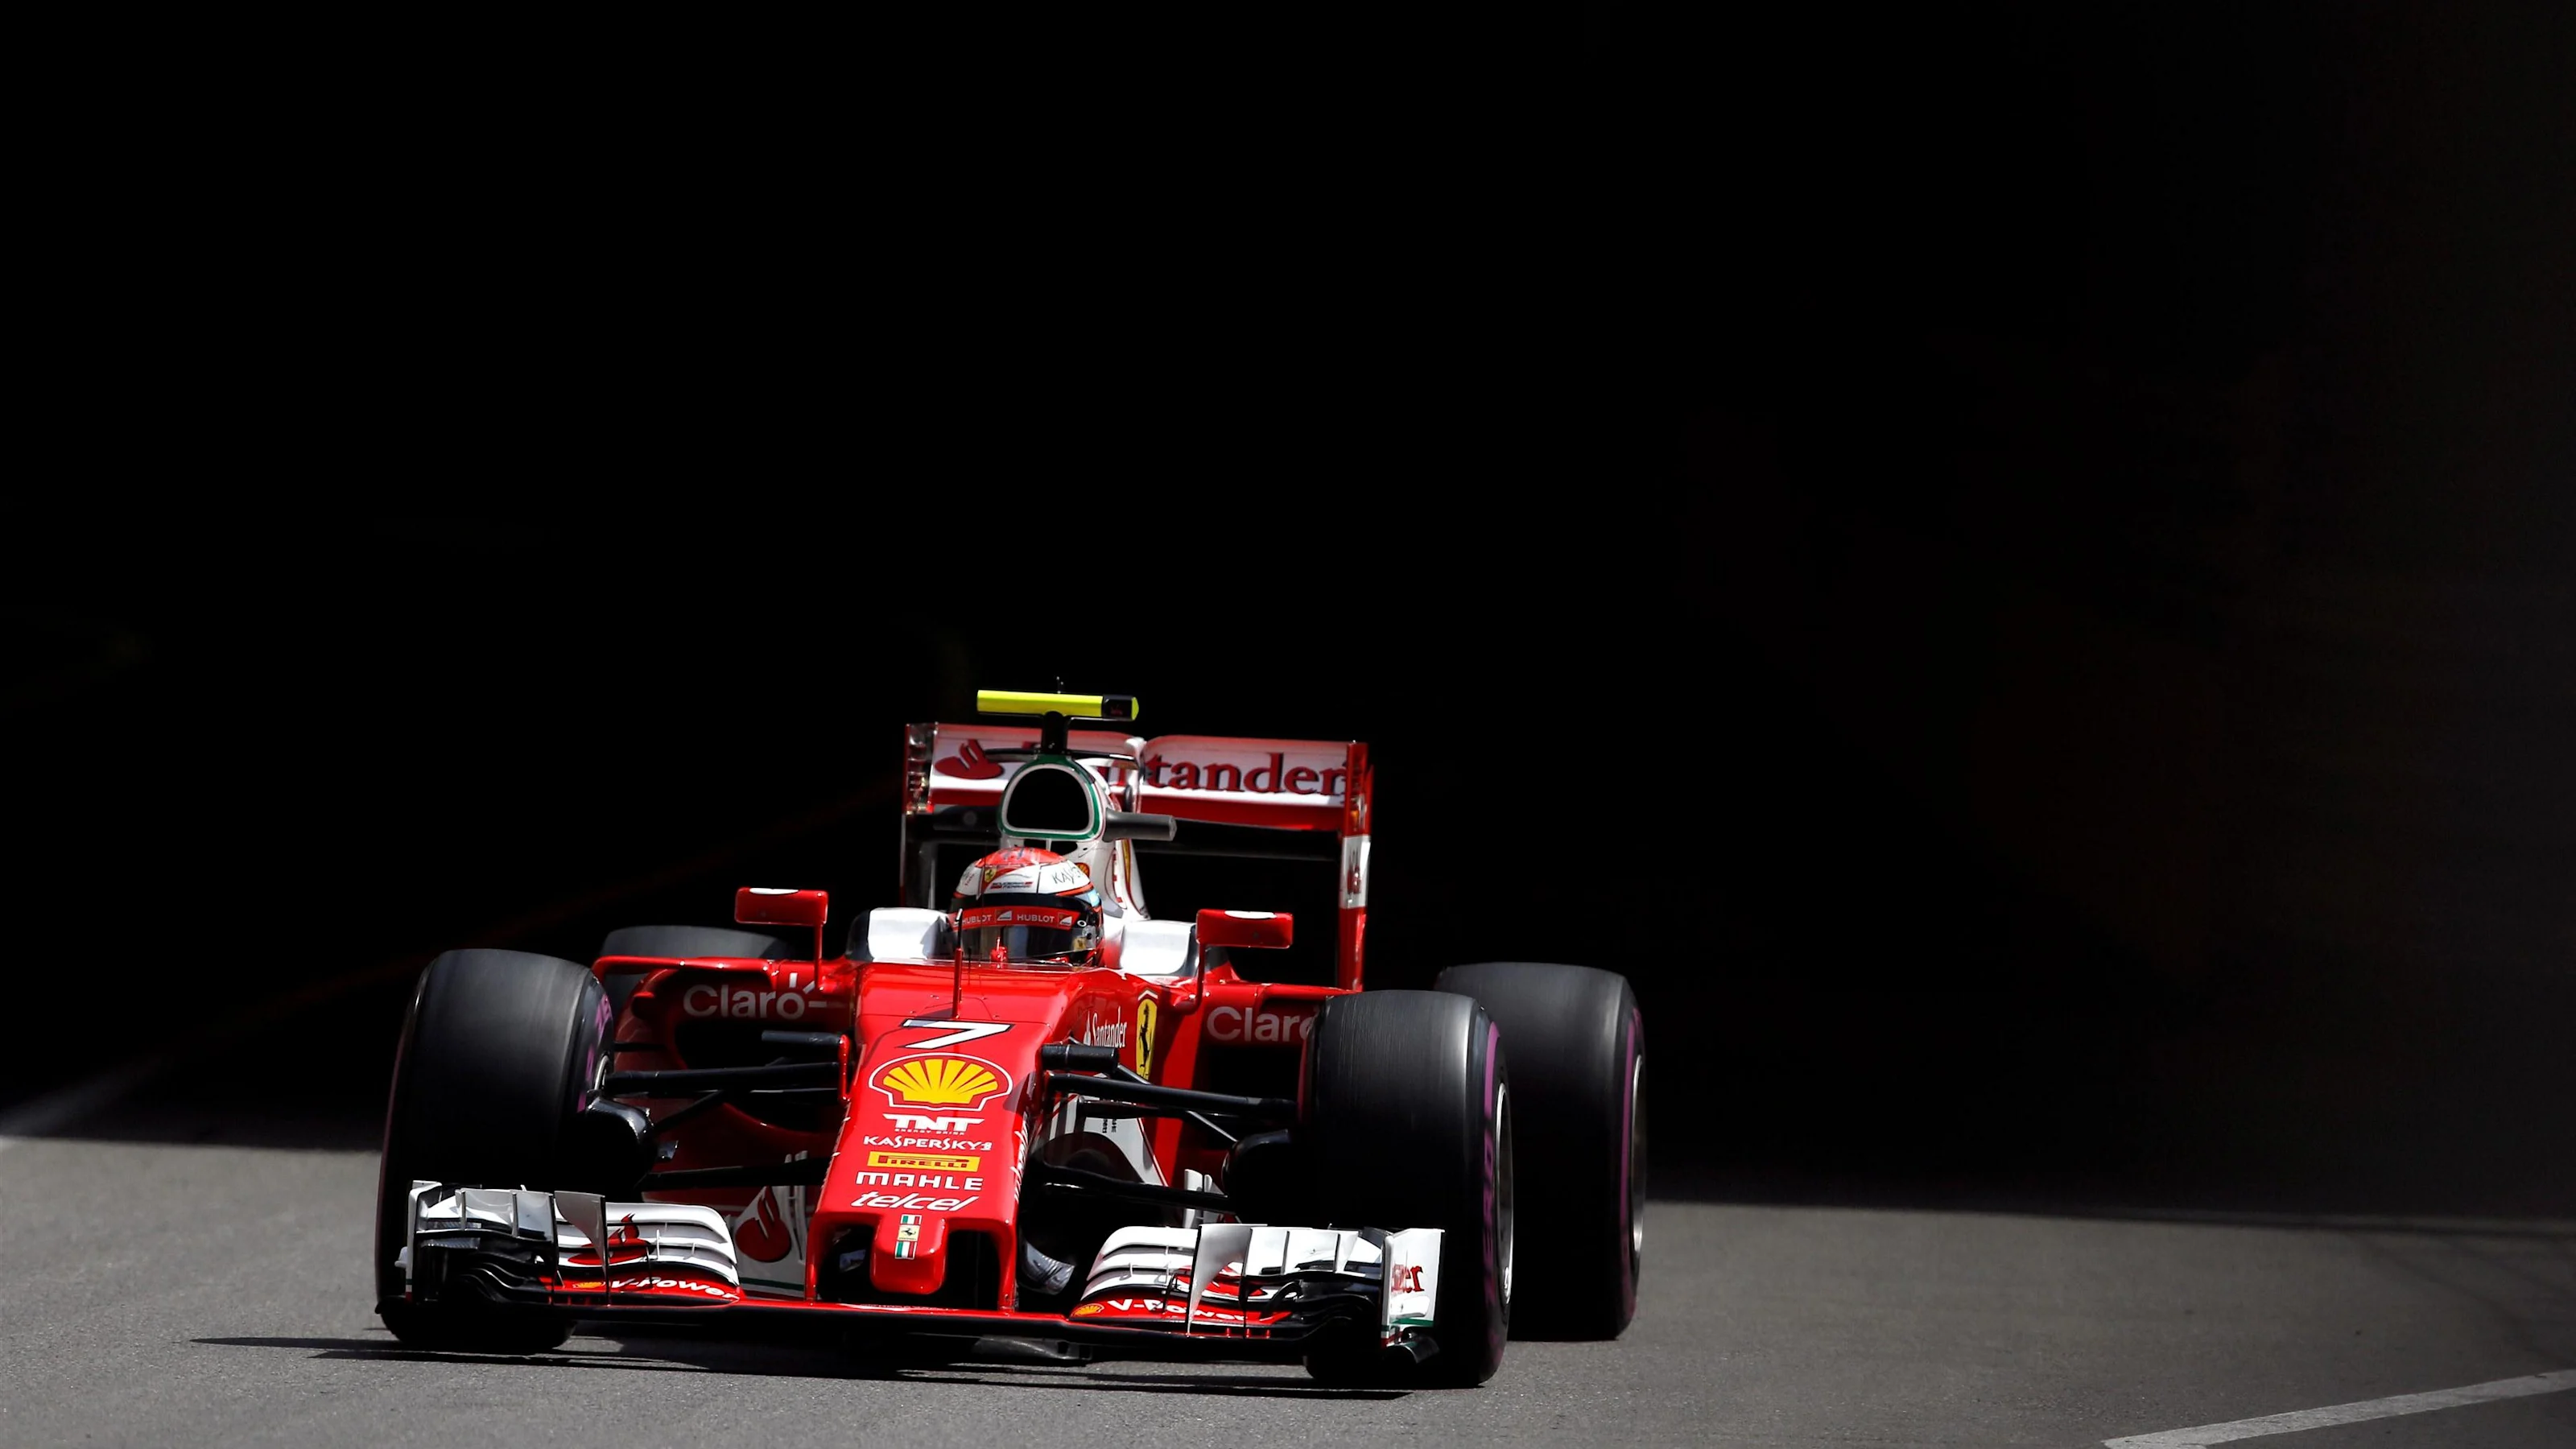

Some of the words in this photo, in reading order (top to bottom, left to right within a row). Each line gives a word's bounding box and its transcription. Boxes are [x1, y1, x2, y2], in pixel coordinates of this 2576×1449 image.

[1017, 914, 1055, 923] HUBLOT
[684, 984, 806, 1020] Claro
[897, 1018, 1015, 1050] 7
[1092, 1005, 1127, 1048] Santander
[882, 1113, 985, 1133] TNT
[877, 1154, 969, 1168] PIRELLI
[855, 1171, 984, 1191] MAHLE
[851, 1191, 980, 1212] telcel
